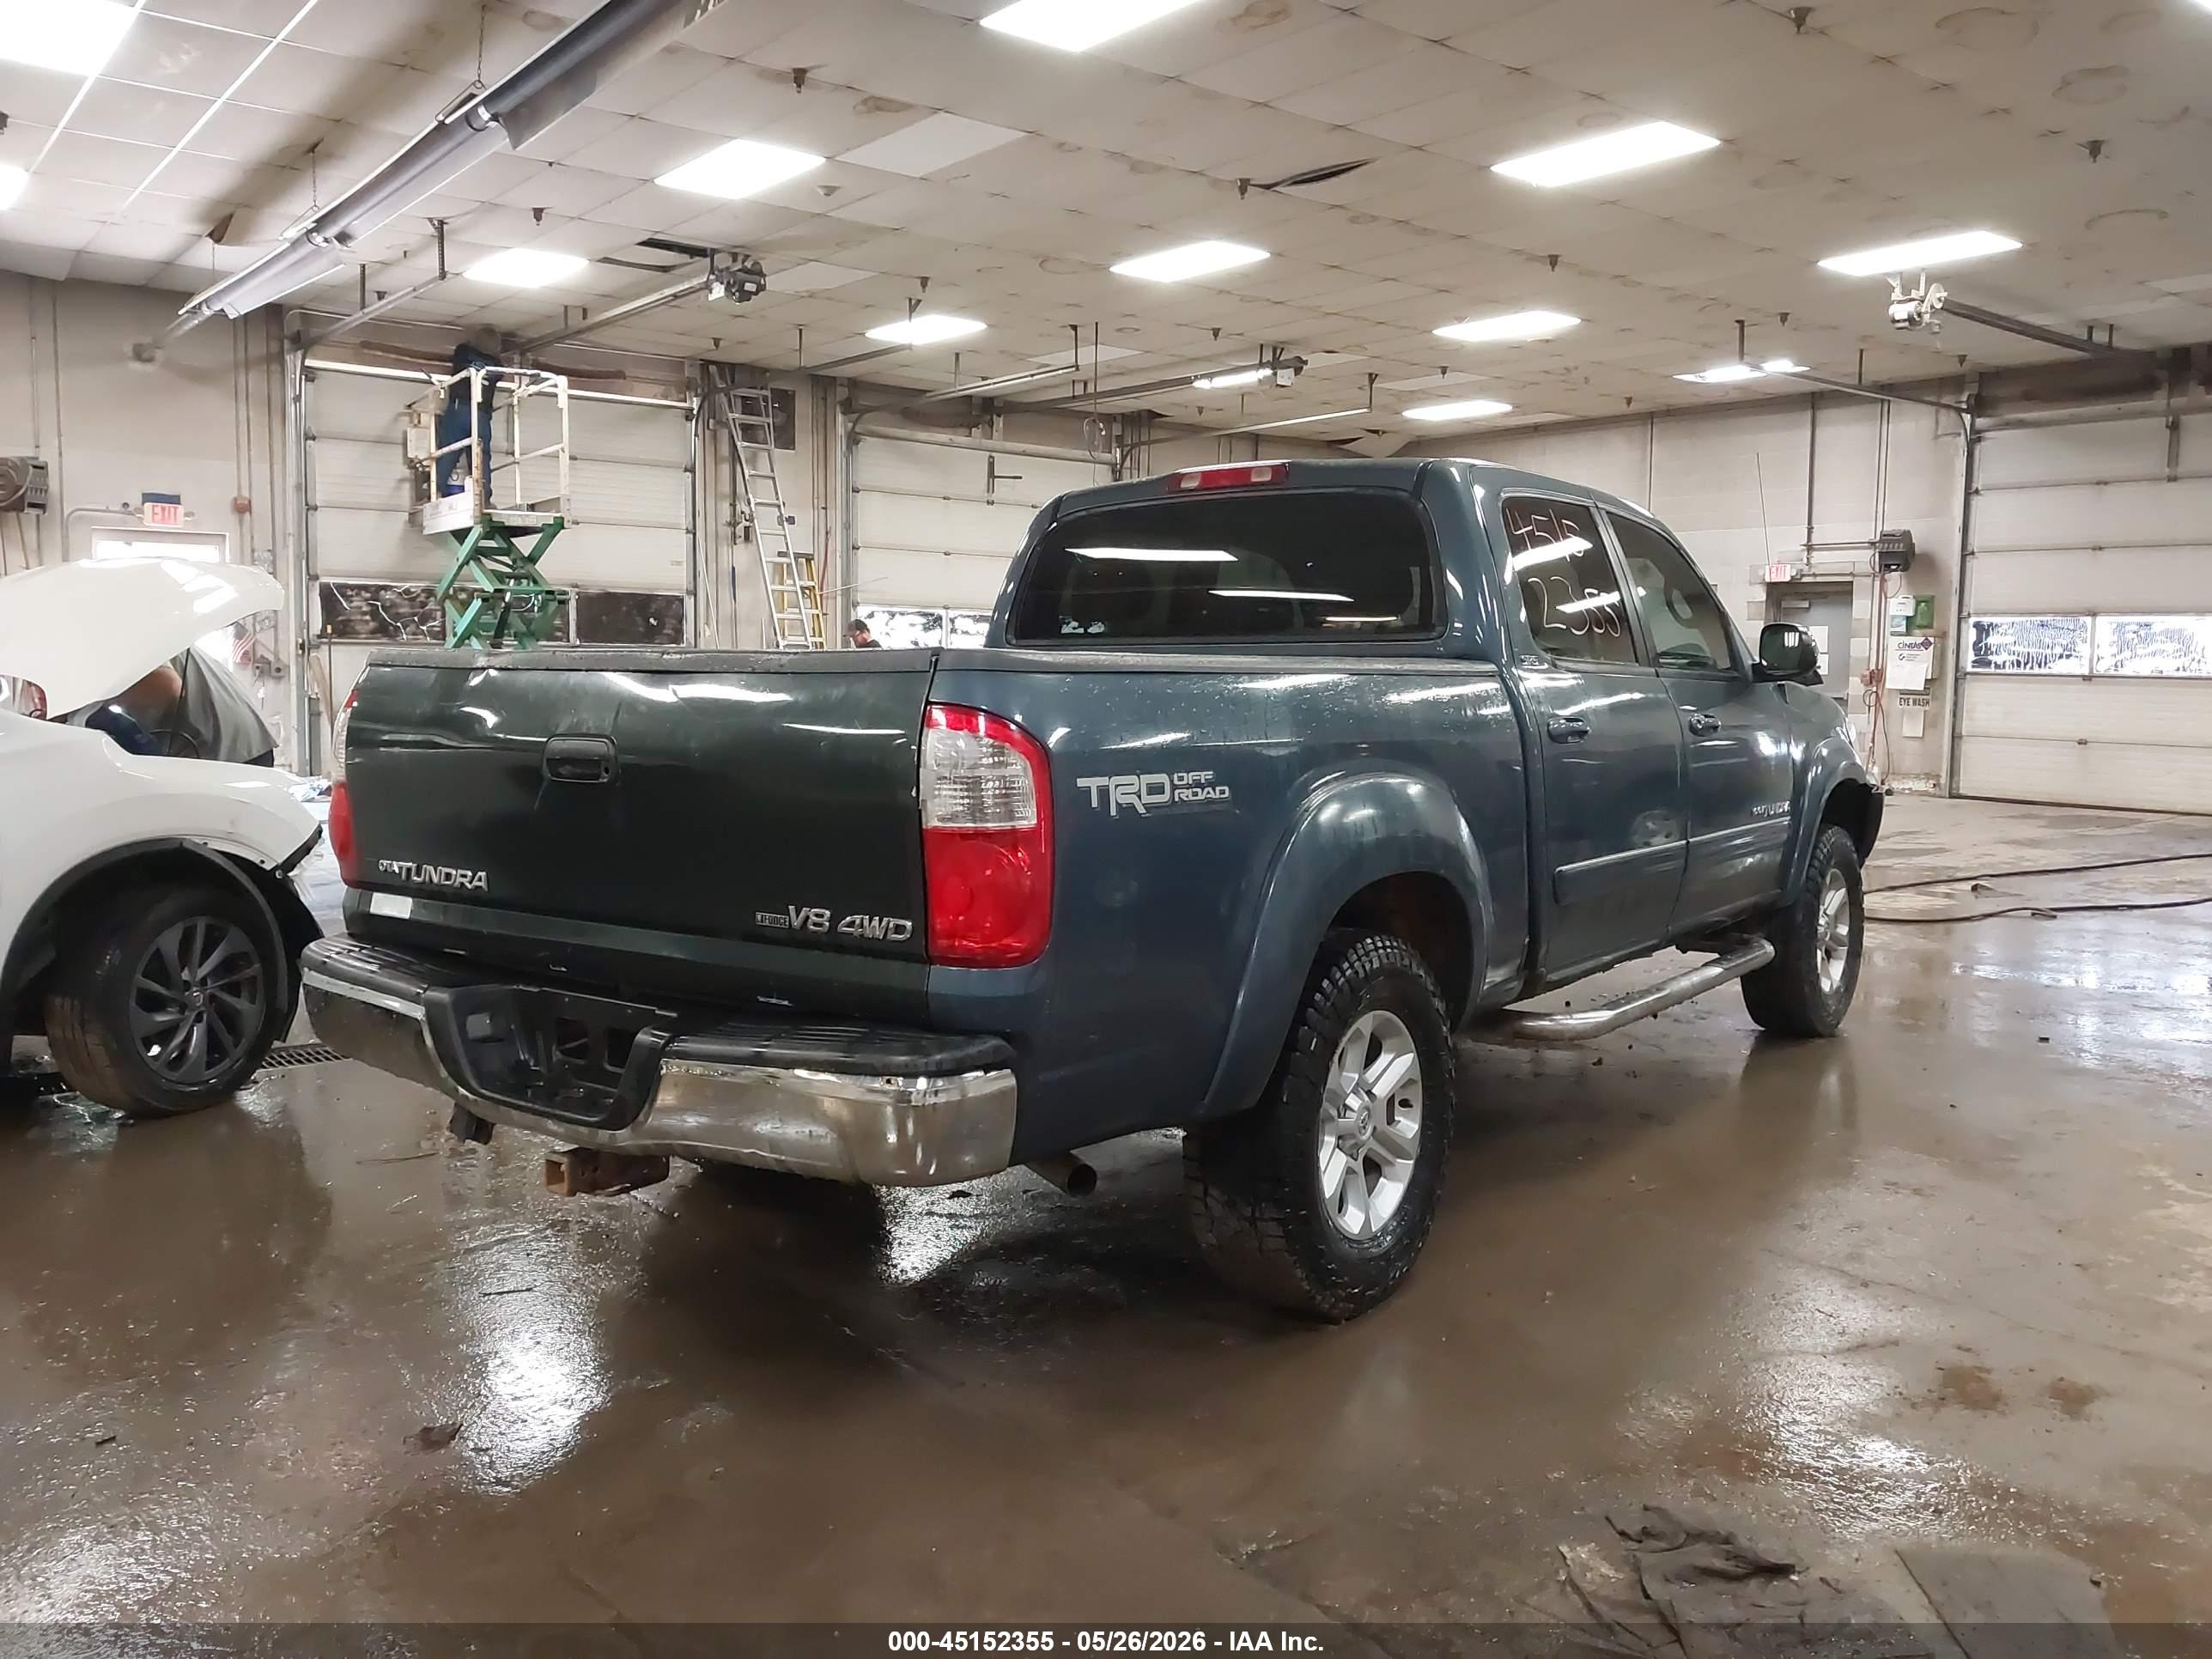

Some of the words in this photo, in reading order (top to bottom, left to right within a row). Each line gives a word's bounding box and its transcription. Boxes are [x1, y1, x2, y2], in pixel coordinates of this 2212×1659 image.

[151, 504, 179, 525] EXIT
[1769, 565, 1787, 578] EXIT
[1899, 697, 1911, 707] EYE
[1911, 697, 1930, 708] WASH
[1174, 771, 1215, 786] OFF
[1077, 773, 1171, 817] TRD
[1174, 786, 1231, 803] ROAD
[397, 861, 489, 892] TUNDRA
[788, 905, 832, 933] V8
[837, 915, 914, 941] 4WD
